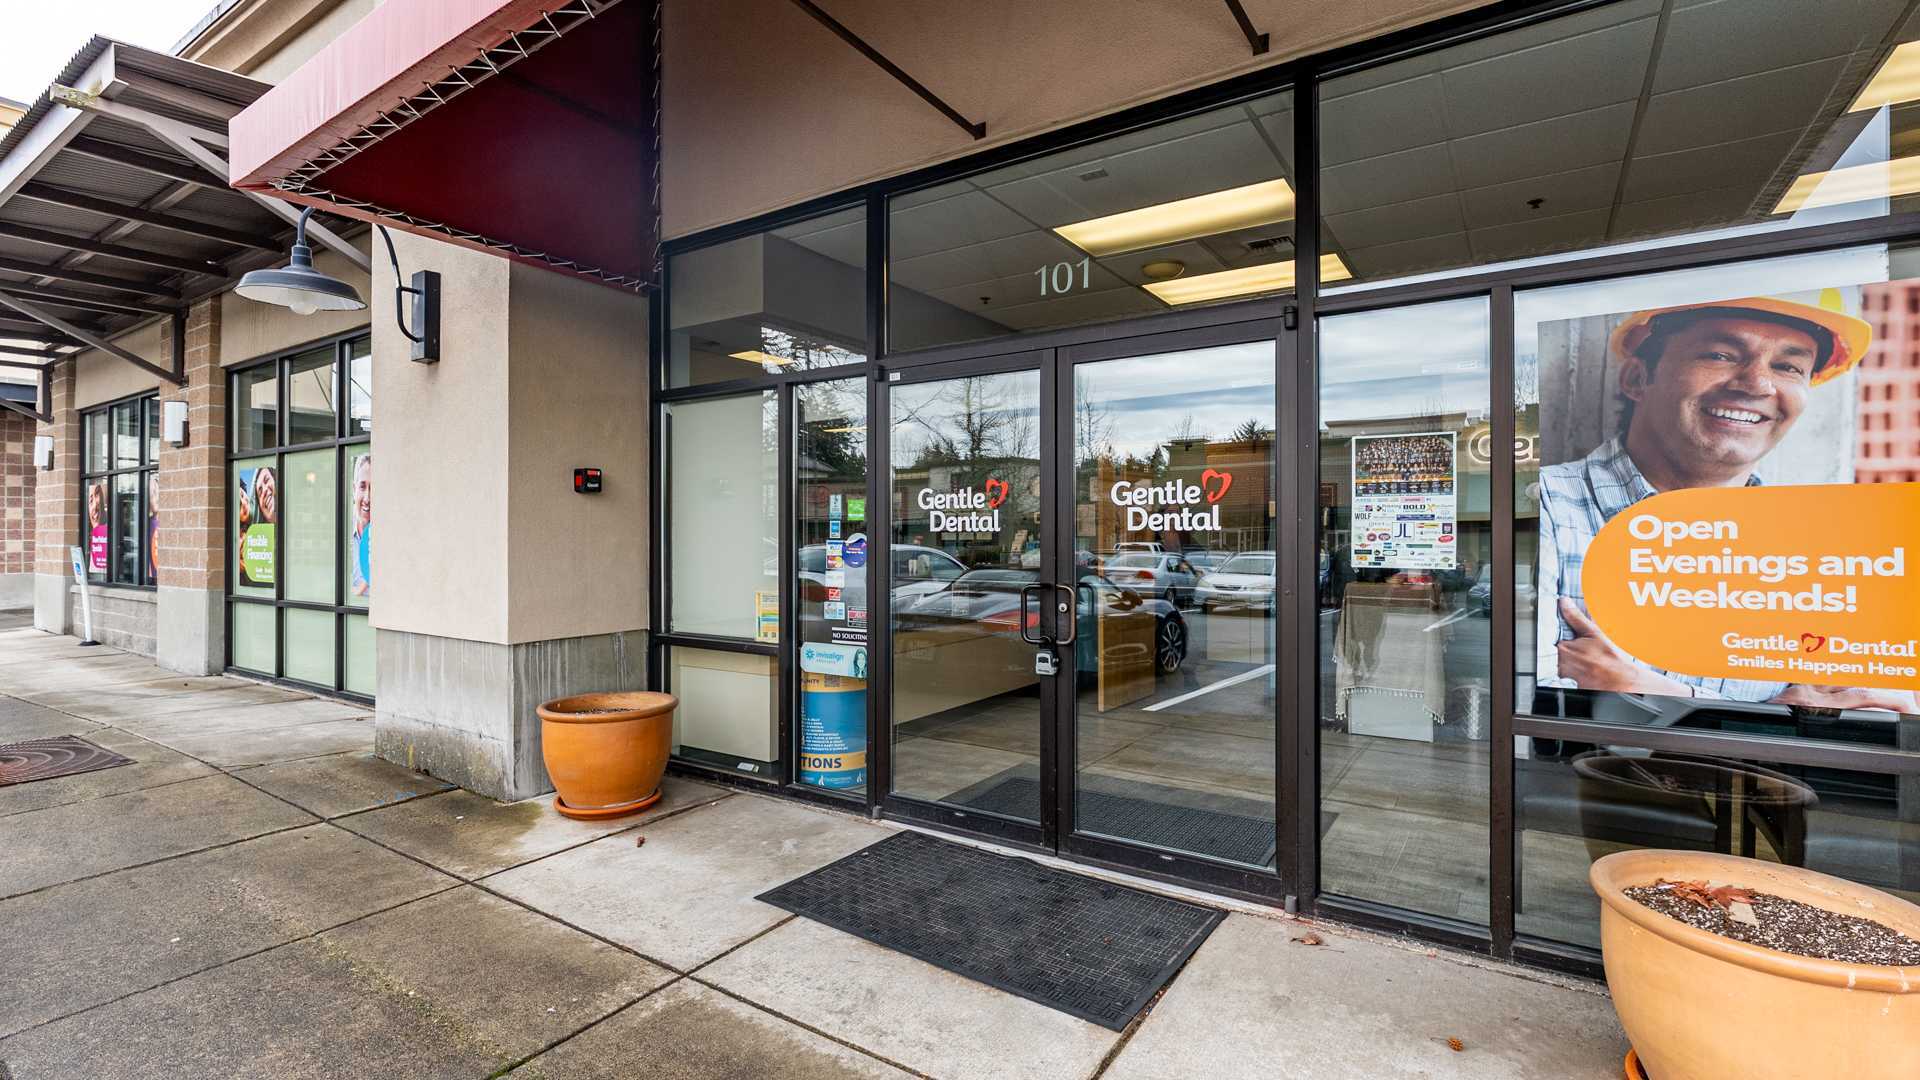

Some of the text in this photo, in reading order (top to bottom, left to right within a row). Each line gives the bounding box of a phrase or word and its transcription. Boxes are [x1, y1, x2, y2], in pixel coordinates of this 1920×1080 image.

[1034, 256, 1089, 296] 101
[917, 486, 985, 510] Gentle
[1110, 479, 1201, 506] Gentle
[929, 509, 1001, 533] Dental
[1127, 504, 1222, 532] Dental
[1354, 512, 1372, 520] WOLF
[1628, 514, 1739, 547] Open
[1630, 547, 1905, 583] Evenings and
[1628, 581, 1857, 613] Weekends!
[832, 631, 841, 639] NO
[1721, 632, 1917, 658] Gentle Dental
[1727, 654, 1917, 677] Smiles Happen Here
[800, 756, 842, 768] TIONS
